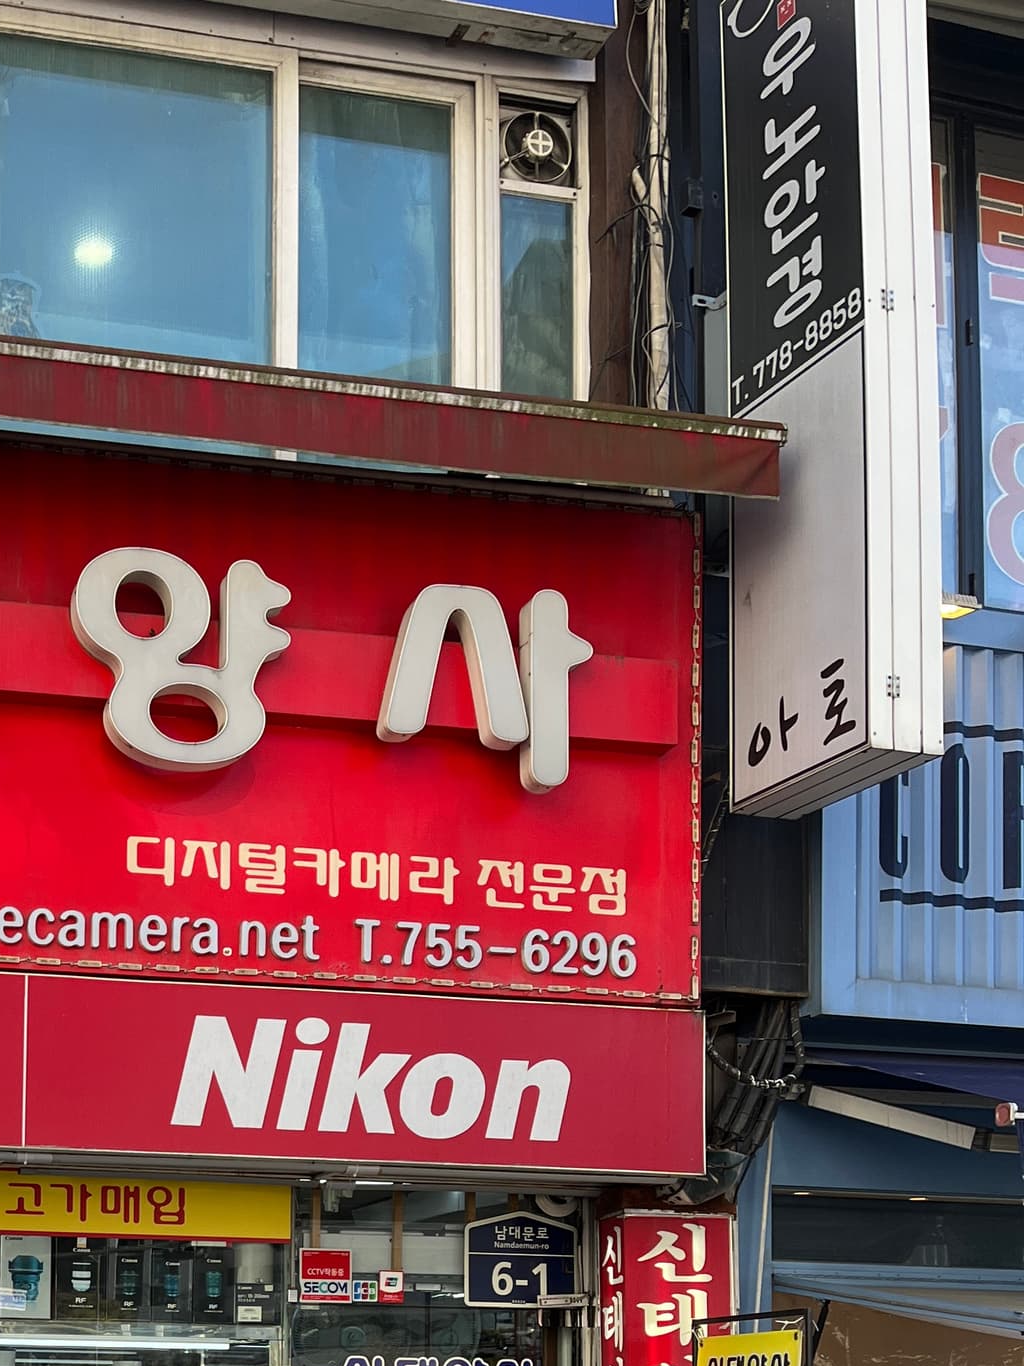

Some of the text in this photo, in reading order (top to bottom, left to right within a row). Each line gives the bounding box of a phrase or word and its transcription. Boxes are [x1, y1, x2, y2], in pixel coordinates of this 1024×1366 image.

[752, 287, 862, 389] 778-8858
[878, 743, 1024, 890] CO
[126, 834, 628, 917] 디지털카메라 전문점
[354, 917, 638, 980] T.755-6296
[170, 1014, 573, 1142] Nikon
[4, 1182, 187, 1227] 고가매입
[494, 1240, 550, 1250] Namdaemun-ro
[495, 1225, 550, 1242] 남대문로
[303, 1281, 348, 1294] SECOM
[492, 1261, 548, 1296] 6-1
